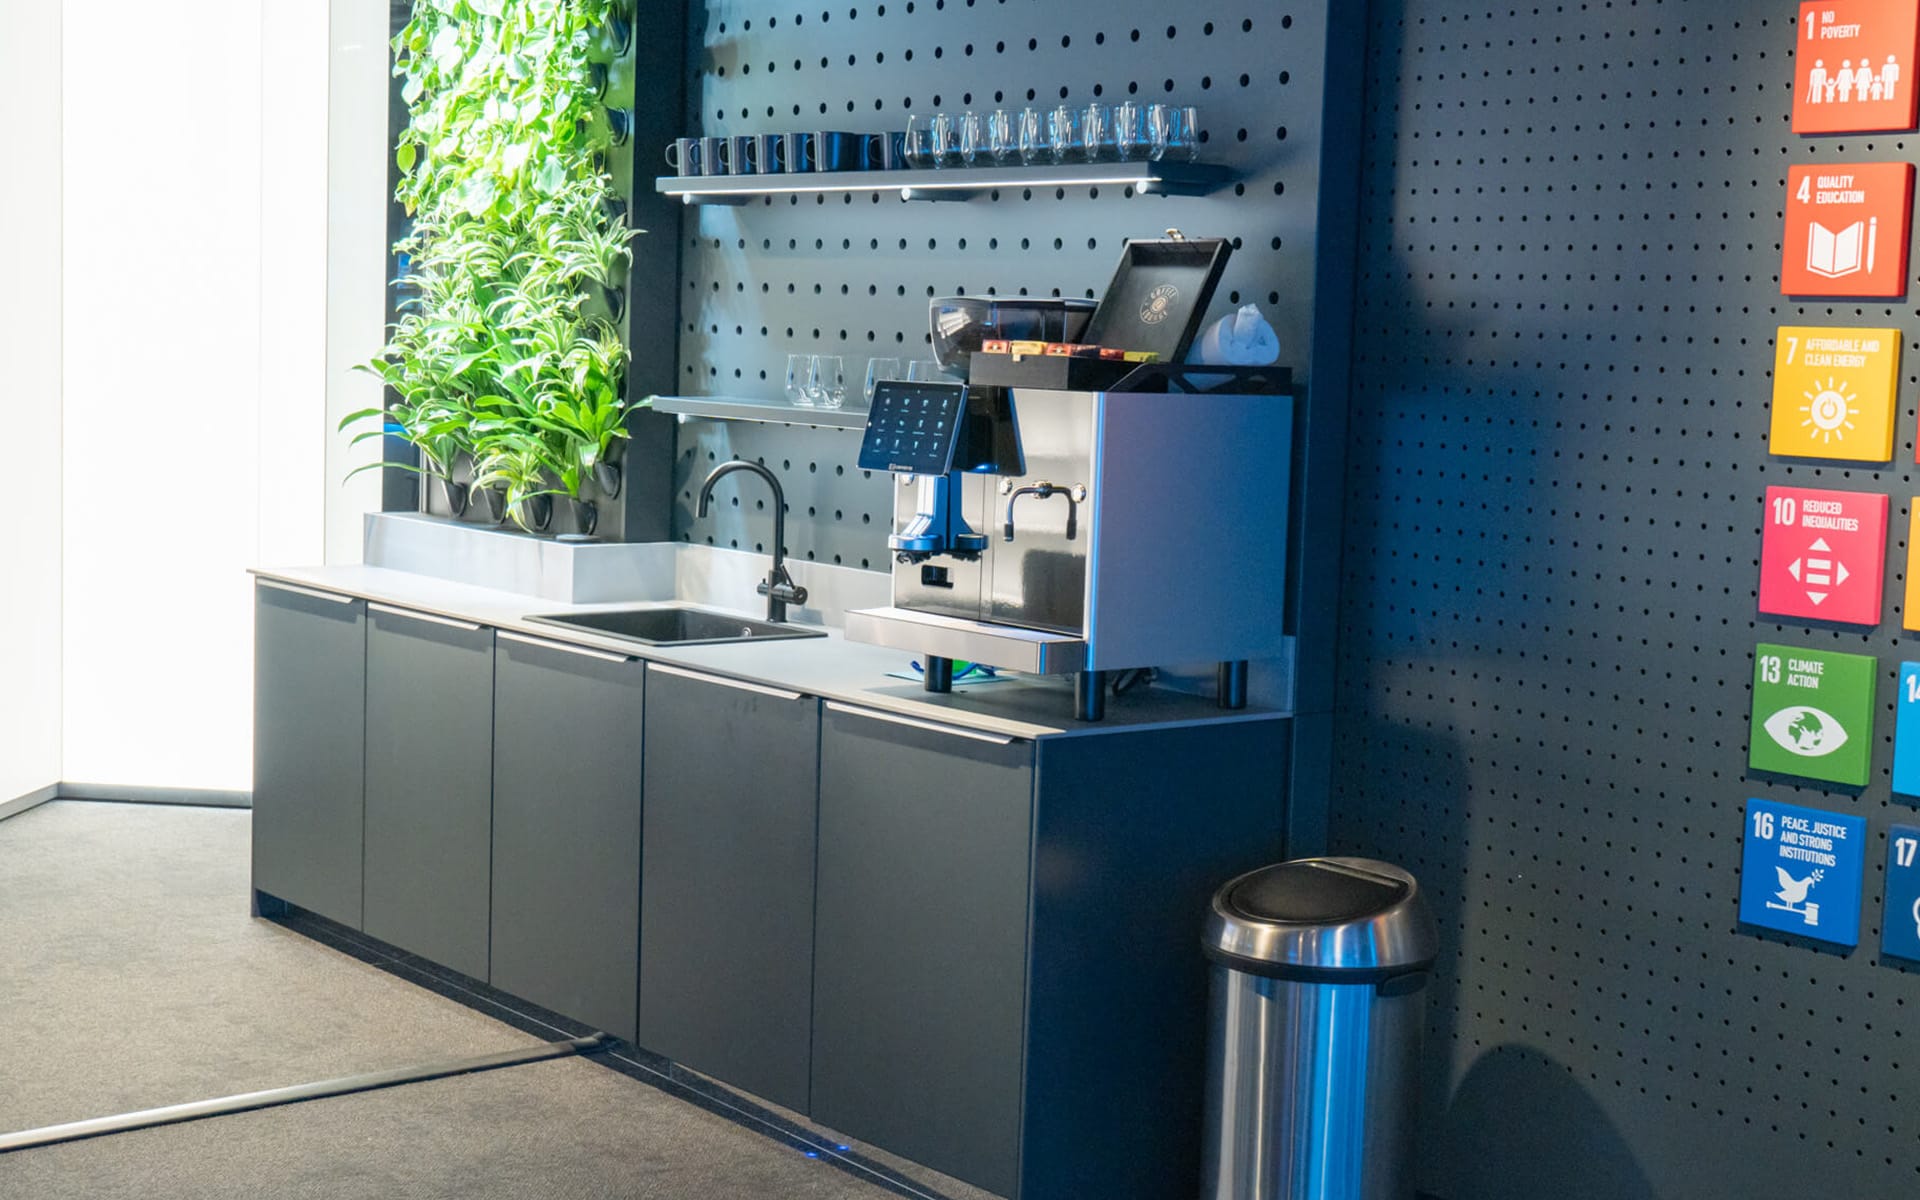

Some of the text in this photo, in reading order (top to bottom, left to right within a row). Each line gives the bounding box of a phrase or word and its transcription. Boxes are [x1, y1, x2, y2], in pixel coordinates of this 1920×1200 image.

[1805, 11, 1815, 40] 1
[1822, 11, 1835, 24] NO
[1820, 24, 1861, 39] POVERTY
[1796, 176, 1811, 204] 4
[1817, 175, 1854, 189] QUALITY
[1816, 190, 1864, 204] EDUCATION
[1786, 337, 1798, 365] 7
[1805, 338, 1880, 353] AFFORDABLE AND
[1805, 354, 1867, 368] CLEAN ENERGY
[1773, 497, 1796, 526] 10
[1803, 499, 1842, 514] REDUCED
[1802, 515, 1859, 532] INEQUALITIES
[1760, 655, 1781, 684] 13
[1788, 659, 1824, 675] CLIMATE
[1787, 674, 1819, 689] ACTION
[1753, 811, 1775, 840] 16
[1812, 822, 1847, 840] JUSTICE
[1780, 831, 1833, 852] AND STRONG
[1779, 845, 1836, 868] INSTITUTIONS
[1895, 837, 1918, 868] 17
